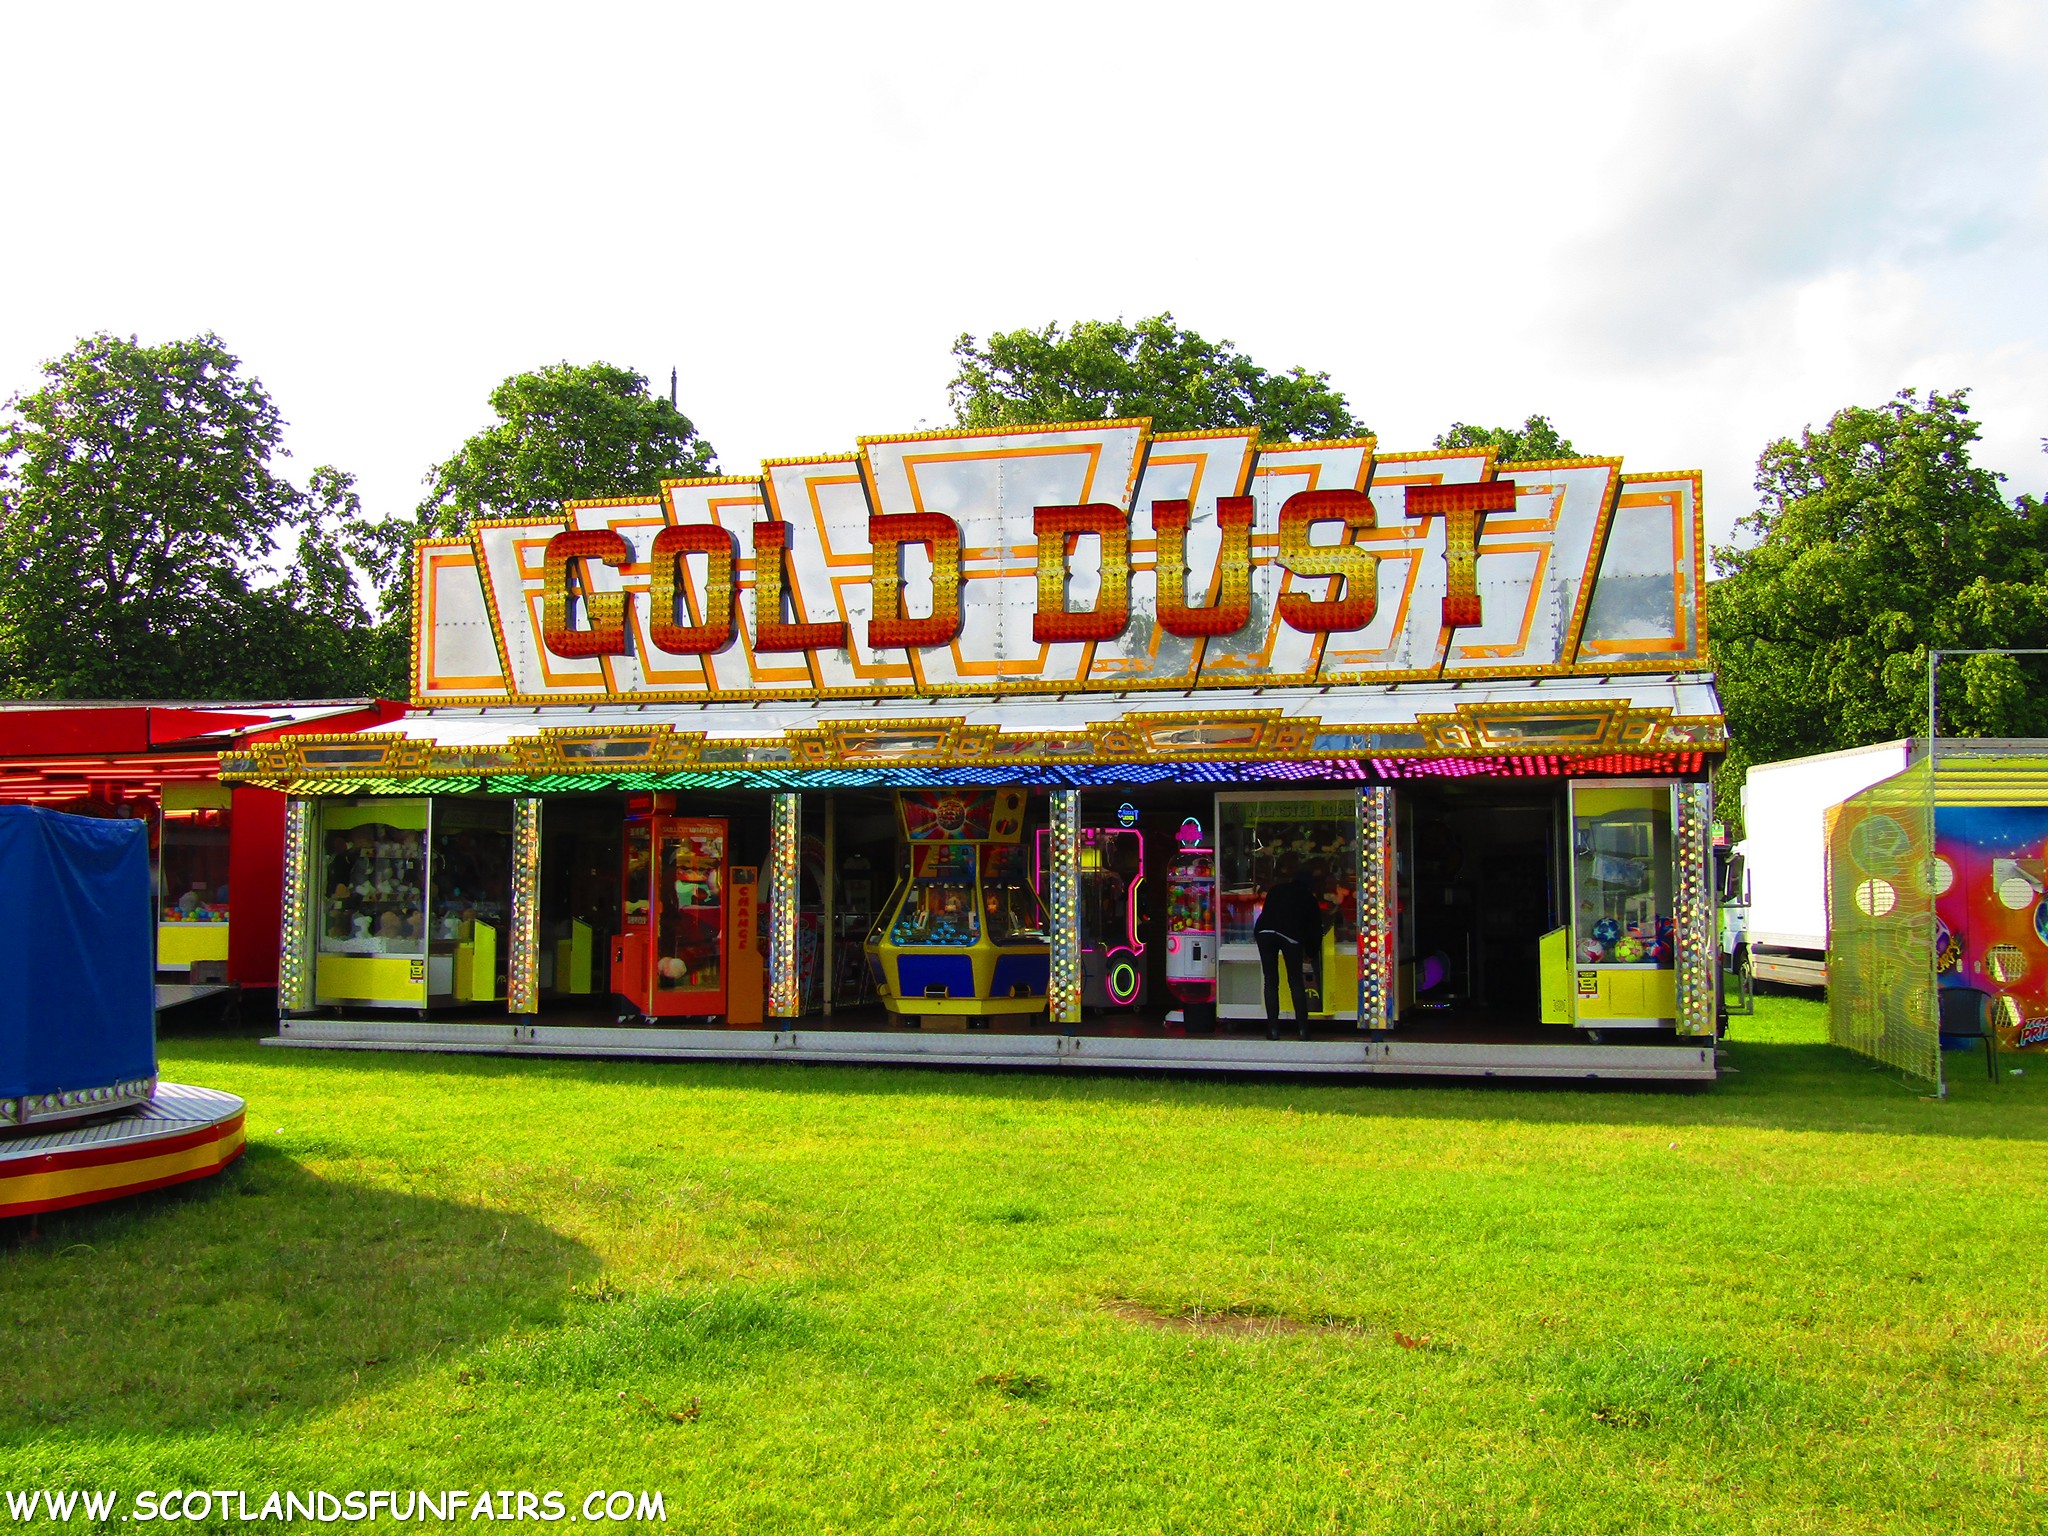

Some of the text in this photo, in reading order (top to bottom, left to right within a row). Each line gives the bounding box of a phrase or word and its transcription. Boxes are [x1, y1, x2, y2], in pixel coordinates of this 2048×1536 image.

[542, 480, 1517, 659] GOLD DUST
[737, 886, 750, 950] CHANGE
